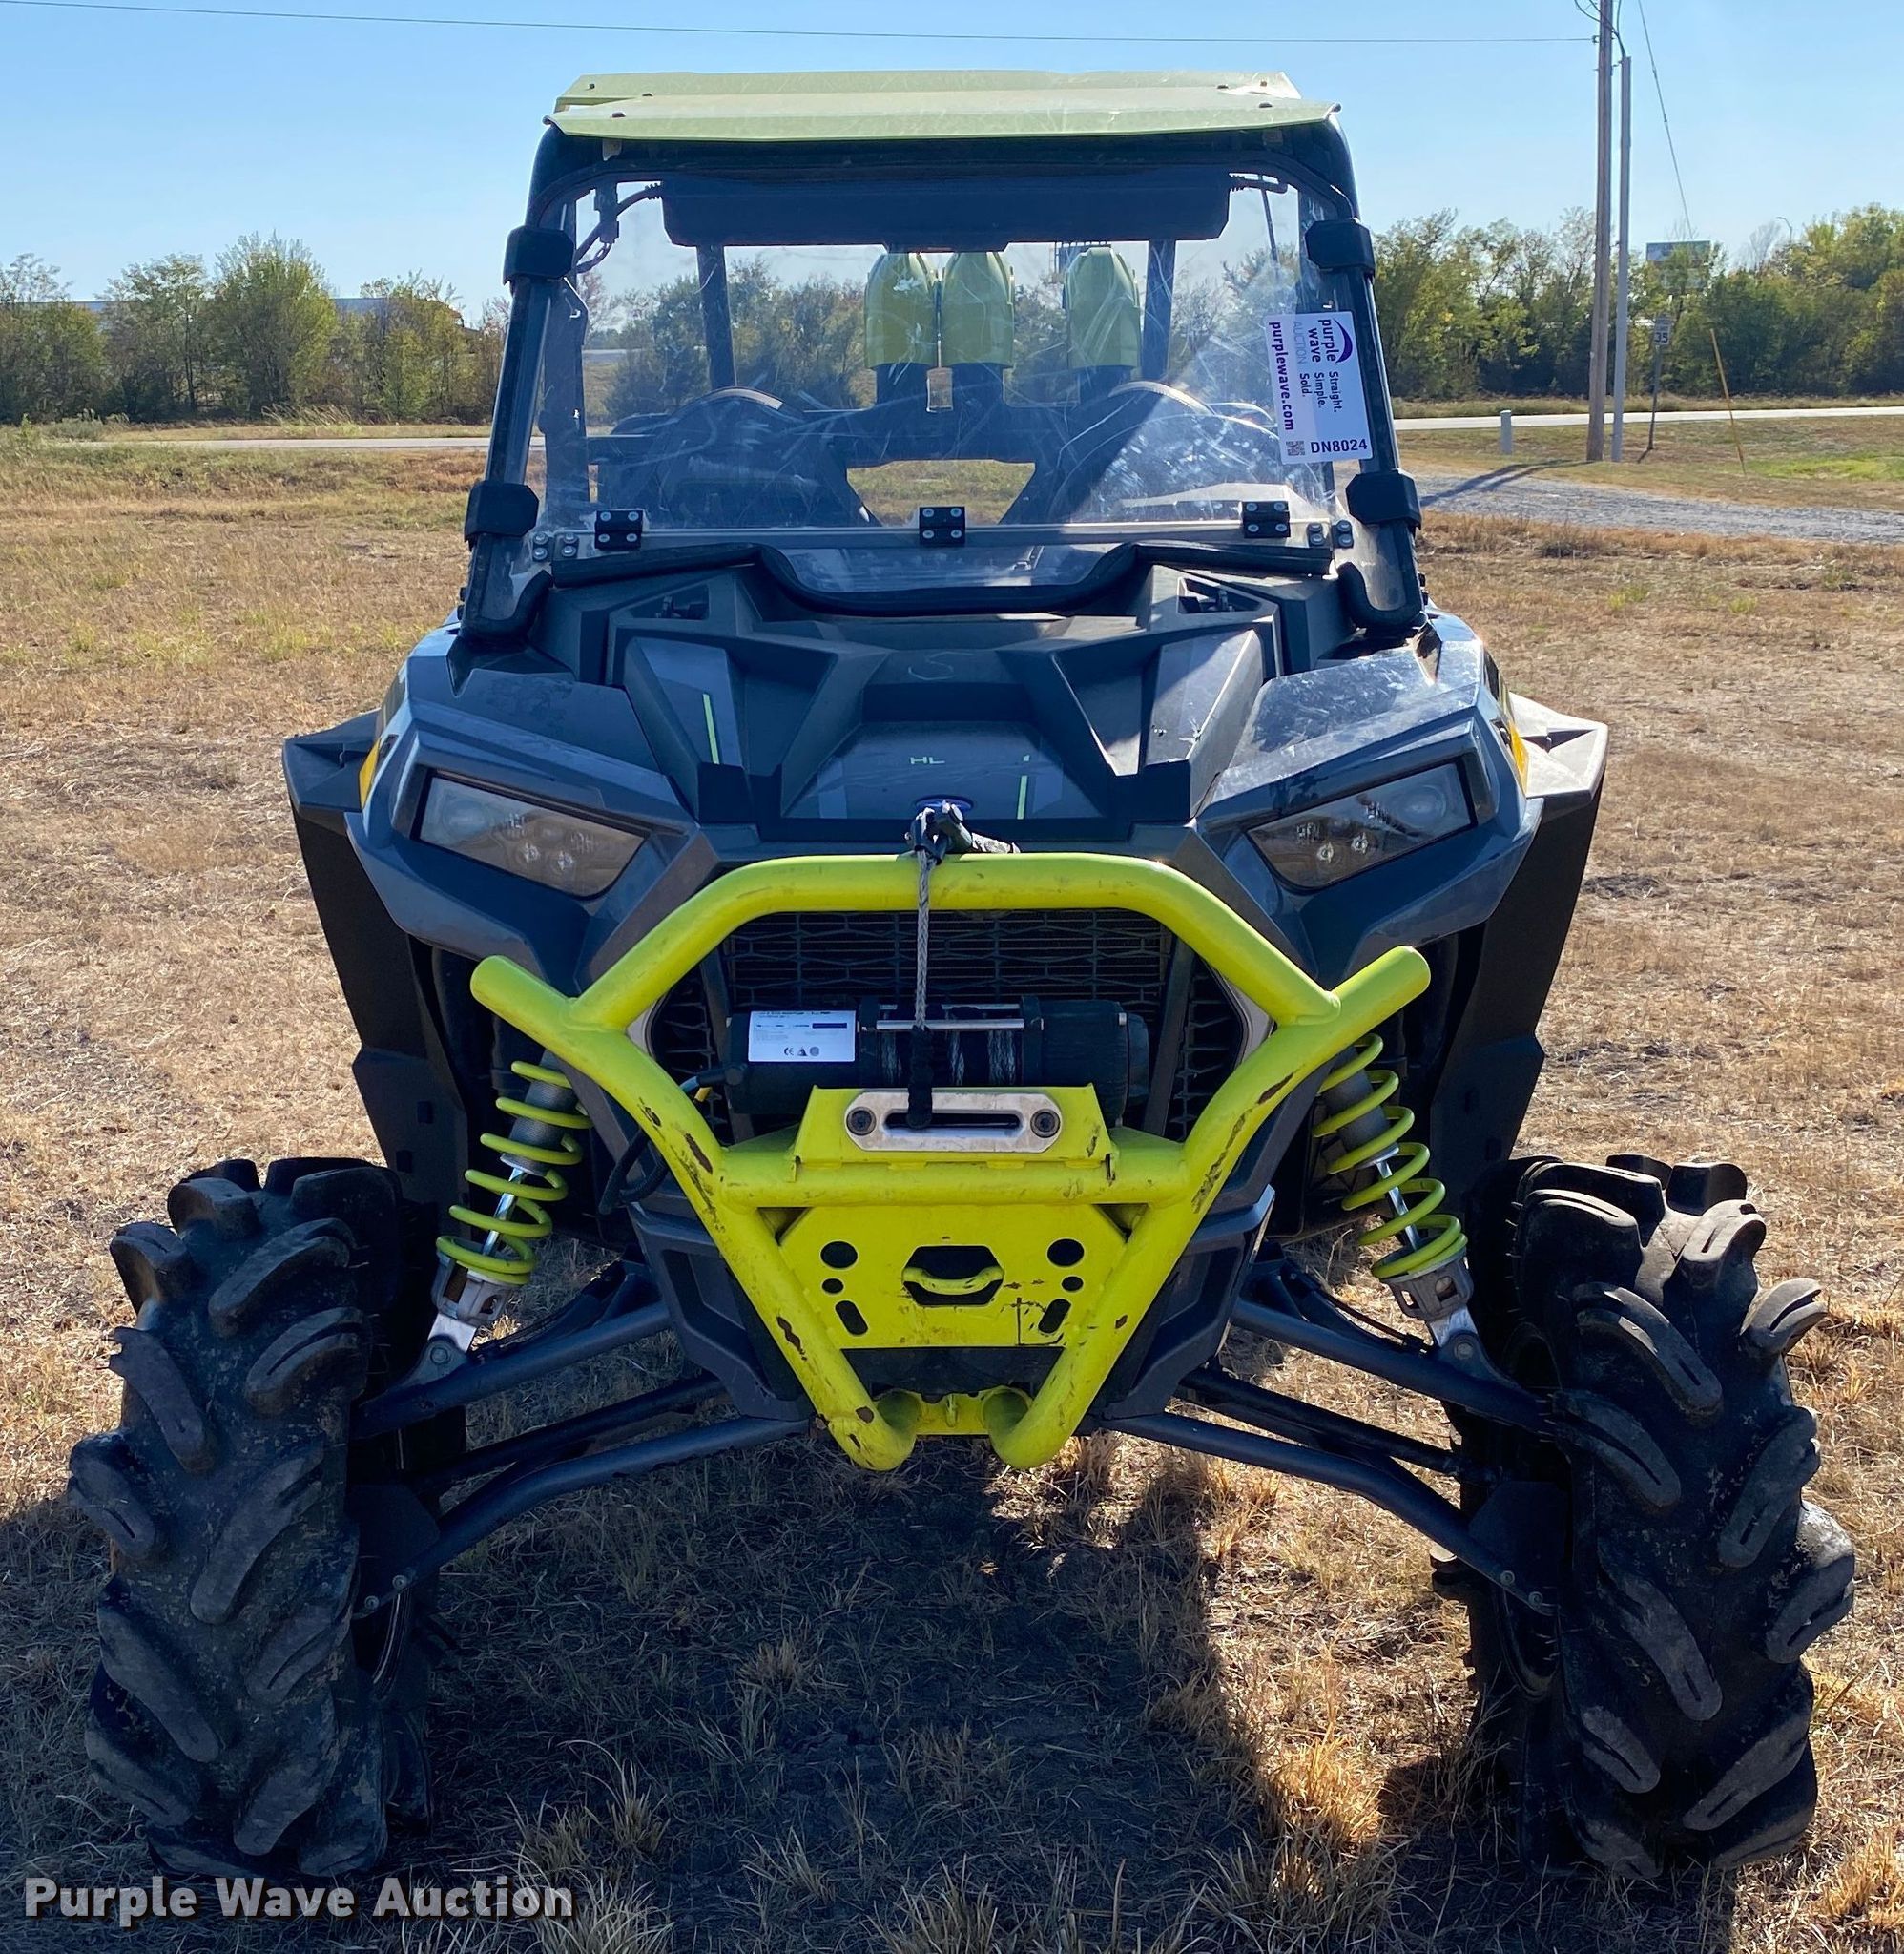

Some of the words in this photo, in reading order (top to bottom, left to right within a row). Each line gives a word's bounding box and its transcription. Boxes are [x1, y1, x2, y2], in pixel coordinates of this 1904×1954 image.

[1293, 321, 1308, 364] AUCTION
[1308, 327, 1321, 363] wave
[1318, 319, 1336, 362] purple
[1654, 332, 1668, 343] 35
[1269, 322, 1294, 430] purplewave.com
[1299, 373, 1312, 397] Sold.
[1314, 372, 1328, 408] Simple.
[1329, 371, 1343, 413] Straight.
[1311, 439, 1368, 454] DN8024
